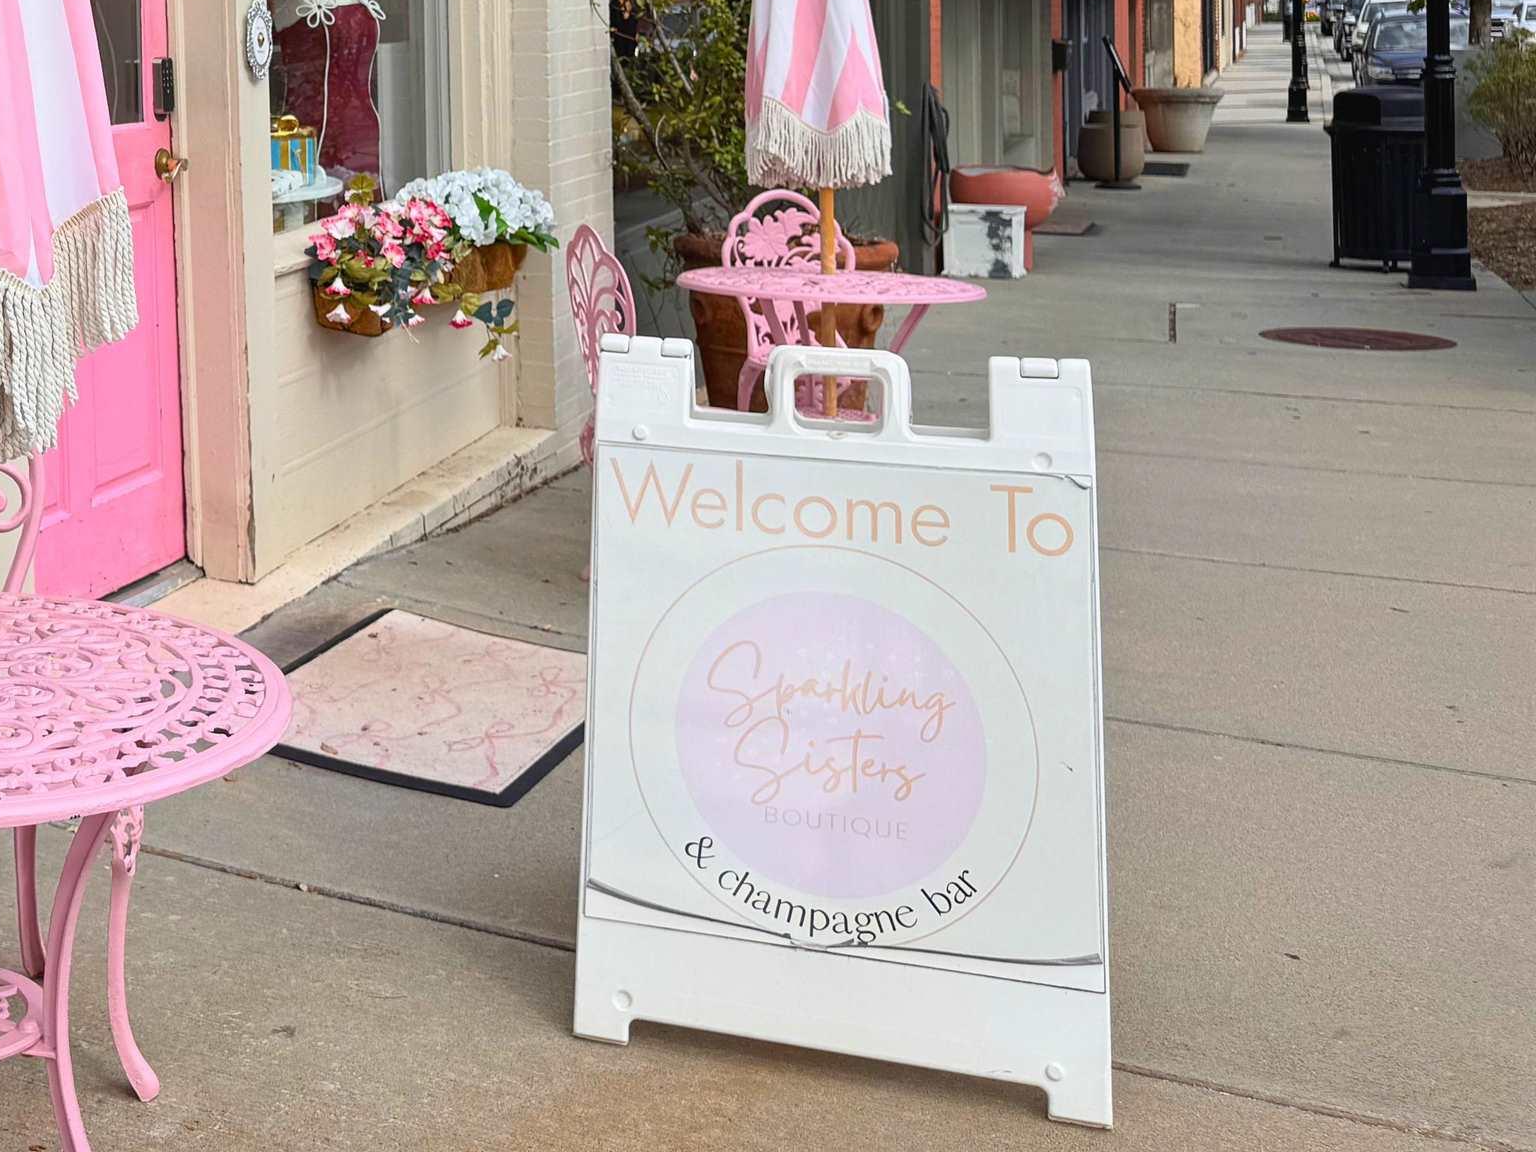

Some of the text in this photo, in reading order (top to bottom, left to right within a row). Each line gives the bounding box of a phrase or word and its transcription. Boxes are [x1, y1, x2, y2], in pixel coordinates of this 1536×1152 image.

[610, 457, 1075, 558] Welcome To
[706, 640, 957, 744] Sparkling
[733, 715, 927, 805] Sisters
[763, 806, 909, 840] BOUTIQUE
[684, 835, 978, 945] & champagne bar
